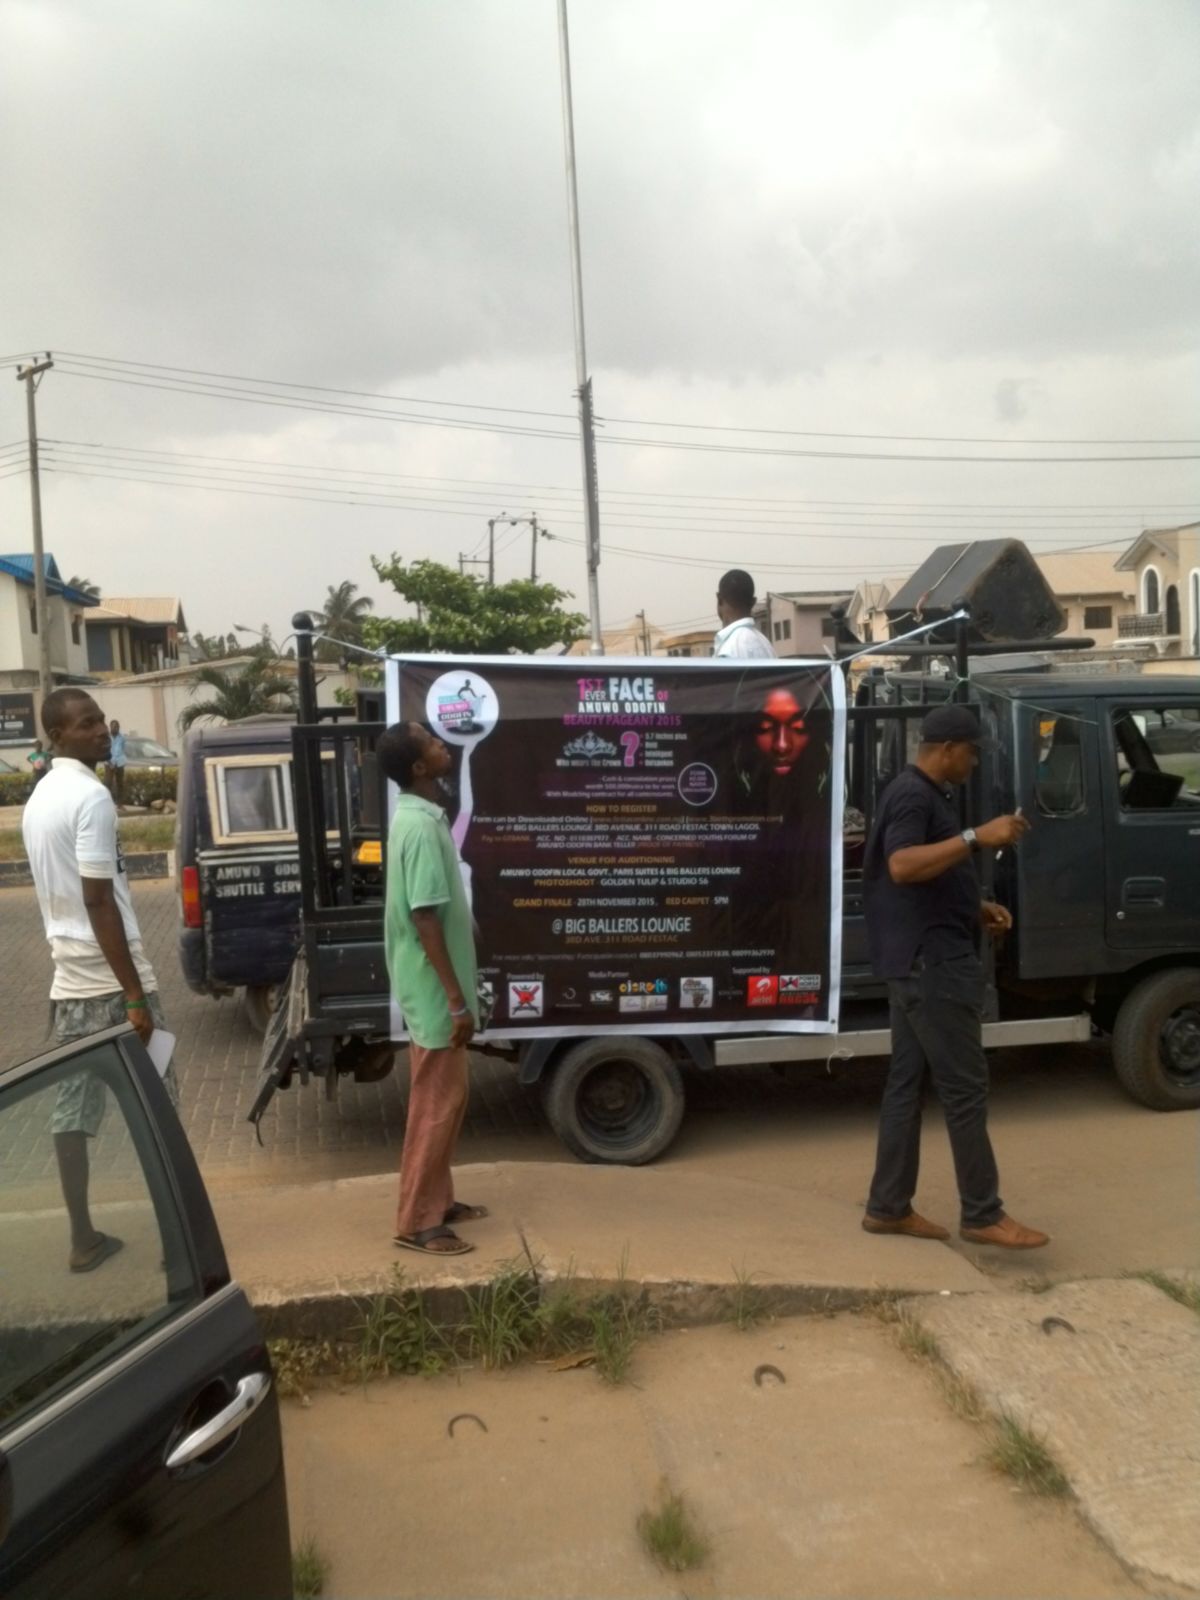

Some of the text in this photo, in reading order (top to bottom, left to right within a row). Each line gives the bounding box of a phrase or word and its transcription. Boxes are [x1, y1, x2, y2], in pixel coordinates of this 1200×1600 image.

[576, 679, 605, 700] 1ST
[609, 677, 654, 701] FACE
[584, 690, 606, 701] EVER
[578, 702, 666, 713] AMUWO ODOFIN
[563, 714, 682, 726] BEAUTY PAGEANT 2015
[586, 804, 657, 813] HOW TO REGISTER
[513, 824, 527, 832] BIG
[528, 824, 560, 832] BALLERS
[682, 823, 708, 831] FESTAC
[710, 823, 734, 831] TOWN
[617, 856, 675, 864] AUDITIONING
[216, 863, 300, 880] AMUWO ODO
[500, 869, 531, 877] AMUWO
[532, 869, 561, 877] ODOFIN
[562, 868, 586, 876] LOCAL
[612, 868, 633, 876] PARIS
[634, 867, 659, 875] SUITES
[666, 867, 679, 875] BIG
[680, 867, 711, 875] BALLERS
[711, 866, 741, 875] LOUNGE
[534, 878, 595, 887] PHOTOSHOOT
[600, 878, 635, 886] GOLDEN
[636, 878, 659, 886] TULIP
[660, 878, 667, 886] &
[667, 878, 698, 886] STUDIO
[216, 880, 302, 898] SHUTTLE SERV
[513, 898, 543, 907] GRAND
[543, 898, 573, 906] FINALE
[597, 897, 636, 906] NOVEMBER
[665, 897, 681, 905] RED
[682, 896, 710, 905] CARPET
[552, 917, 692, 934] @ BIG BALLERS LOUNGE
[732, 967, 760, 975] Supported
[507, 973, 536, 981] Powered
